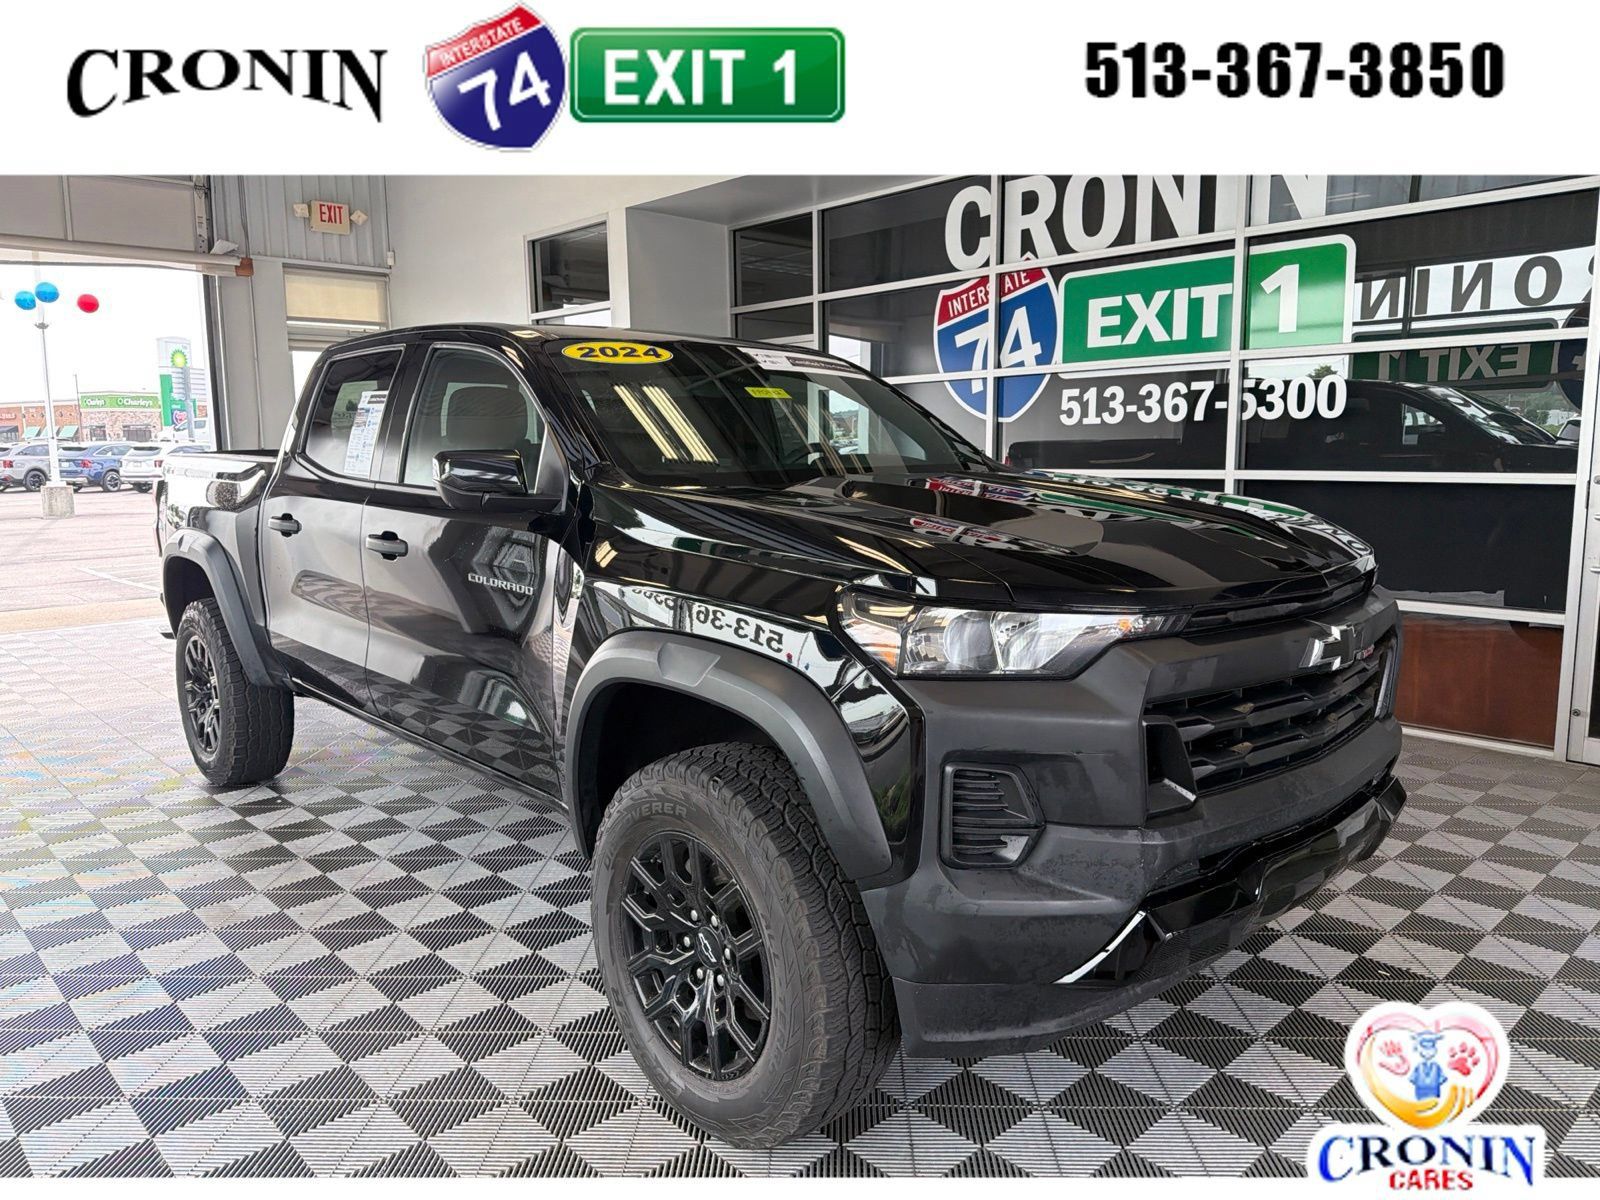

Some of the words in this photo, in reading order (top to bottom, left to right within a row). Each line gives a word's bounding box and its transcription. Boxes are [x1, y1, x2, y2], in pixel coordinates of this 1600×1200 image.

[318, 202, 344, 226] EXIT
[944, 174, 1327, 272] CRONIN
[947, 270, 1031, 318] INTERATE
[1087, 283, 1233, 348] EXIT
[1260, 263, 1301, 333] 1
[575, 344, 665, 360] 2024
[954, 306, 1042, 394] 74
[1059, 373, 1348, 426] 513-367-5300
[467, 572, 535, 596] COLORADO
